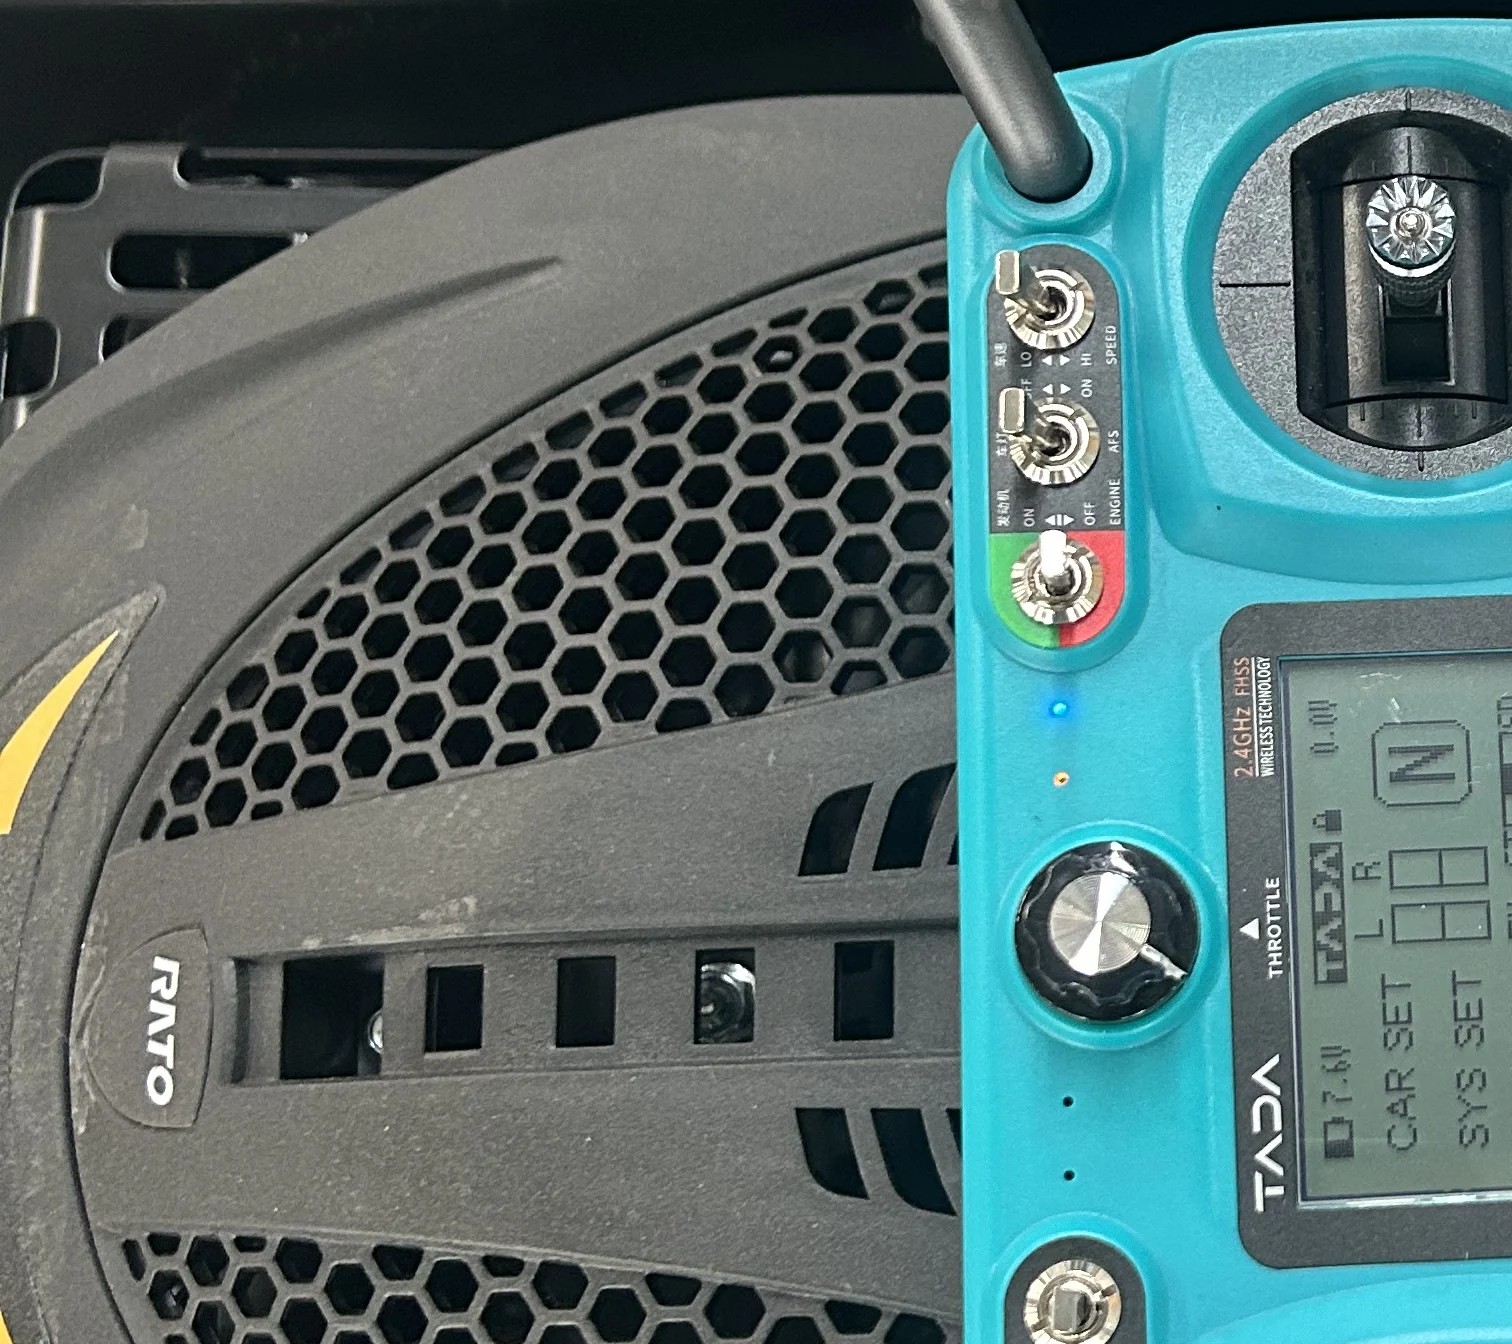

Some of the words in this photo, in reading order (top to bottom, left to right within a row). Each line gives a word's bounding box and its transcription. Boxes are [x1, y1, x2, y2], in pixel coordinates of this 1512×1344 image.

[993, 341, 1008, 367] 车速
[1021, 351, 1032, 367] LO
[1081, 353, 1092, 367] HI
[1104, 325, 1118, 365] SPEED
[1081, 378, 1093, 397] ON
[1107, 429, 1120, 453] AFS
[996, 490, 1010, 527] 发动机
[1024, 508, 1036, 527] ON
[1084, 501, 1096, 526] OFF
[1108, 478, 1121, 526] ENGINE
[1233, 657, 1250, 697] FHSS
[1257, 656, 1273, 724] TECHNOLOGY
[1233, 706, 1254, 777] 2.4GHz
[1308, 700, 1339, 754] 0.0V
[1258, 726, 1275, 776] WIRELESS
[1388, 745, 1456, 782] N
[1352, 862, 1381, 880] R
[1265, 878, 1284, 979] THROTTLE
[1353, 919, 1384, 940] L
[146, 956, 181, 1106] RATO
[1381, 973, 1413, 1051] SET
[1452, 970, 1484, 1048] SET
[1320, 1045, 1352, 1103] 7.6V
[1385, 1068, 1417, 1151] CAR
[1456, 1069, 1489, 1148] SYS
[1252, 1054, 1285, 1213] TADA
